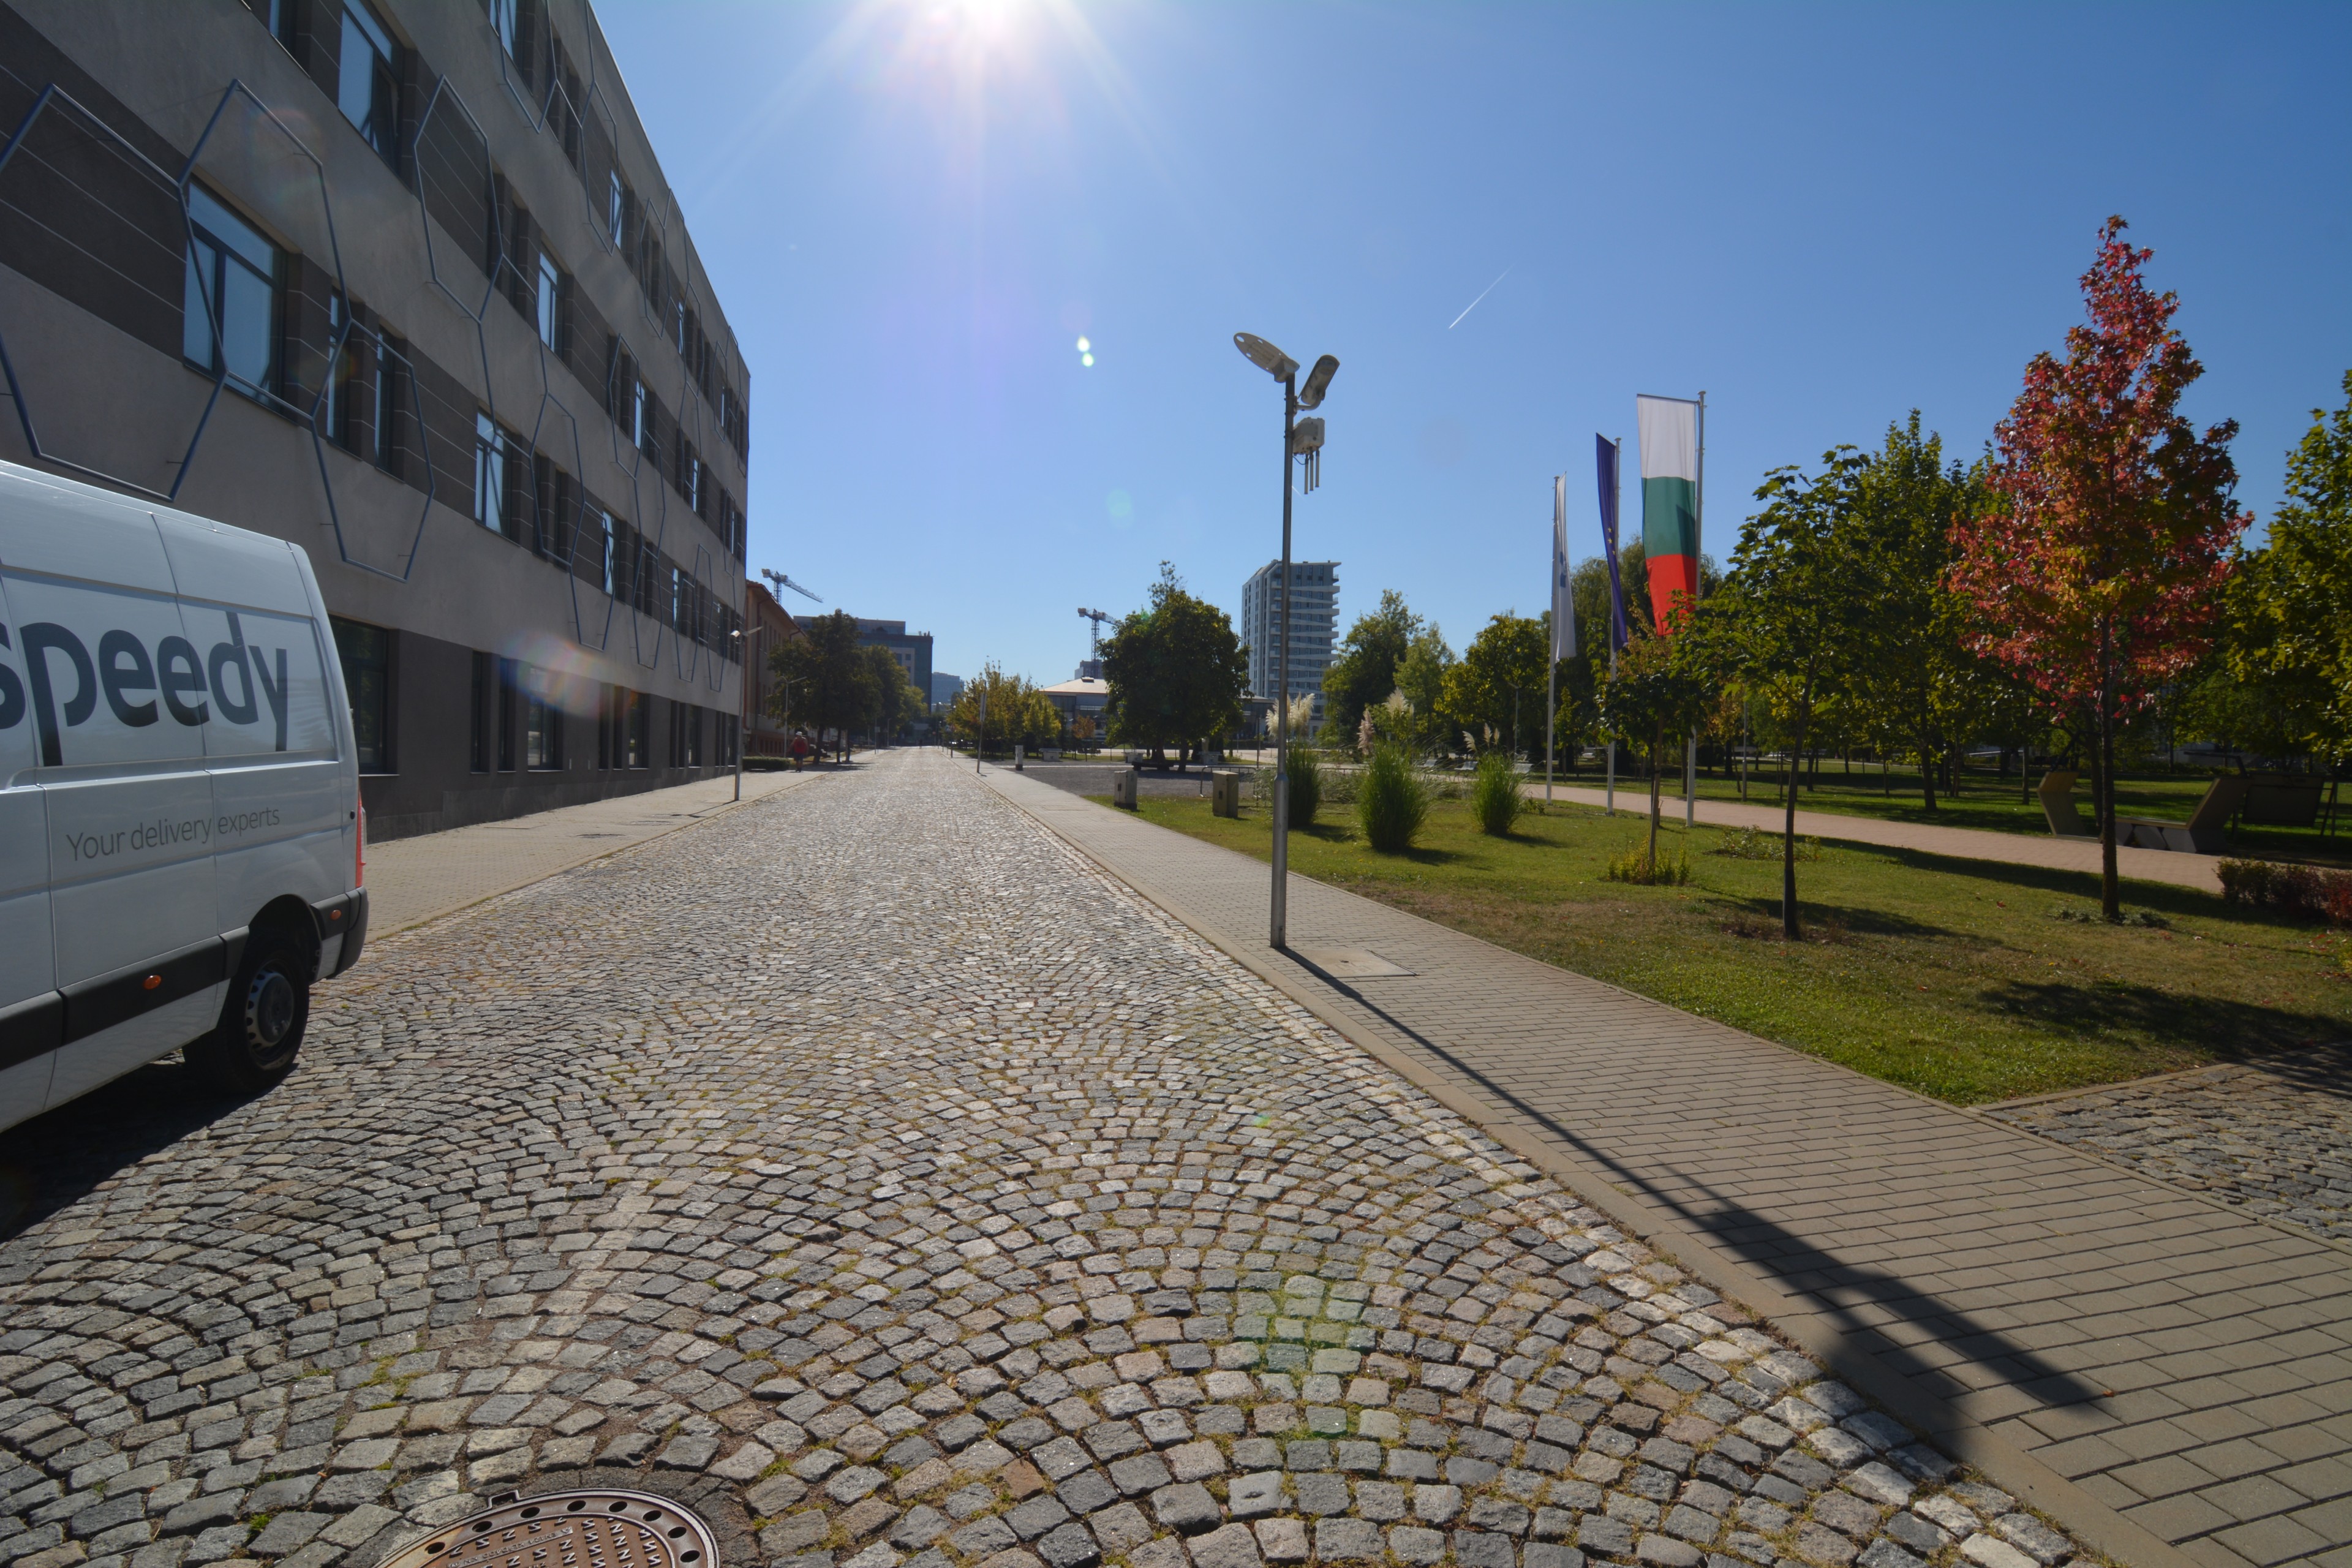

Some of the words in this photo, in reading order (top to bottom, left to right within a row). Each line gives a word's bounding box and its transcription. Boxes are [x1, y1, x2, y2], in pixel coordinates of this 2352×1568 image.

[66, 831, 126, 861] Your
[130, 818, 213, 850] delivery
[217, 807, 280, 837] experts
